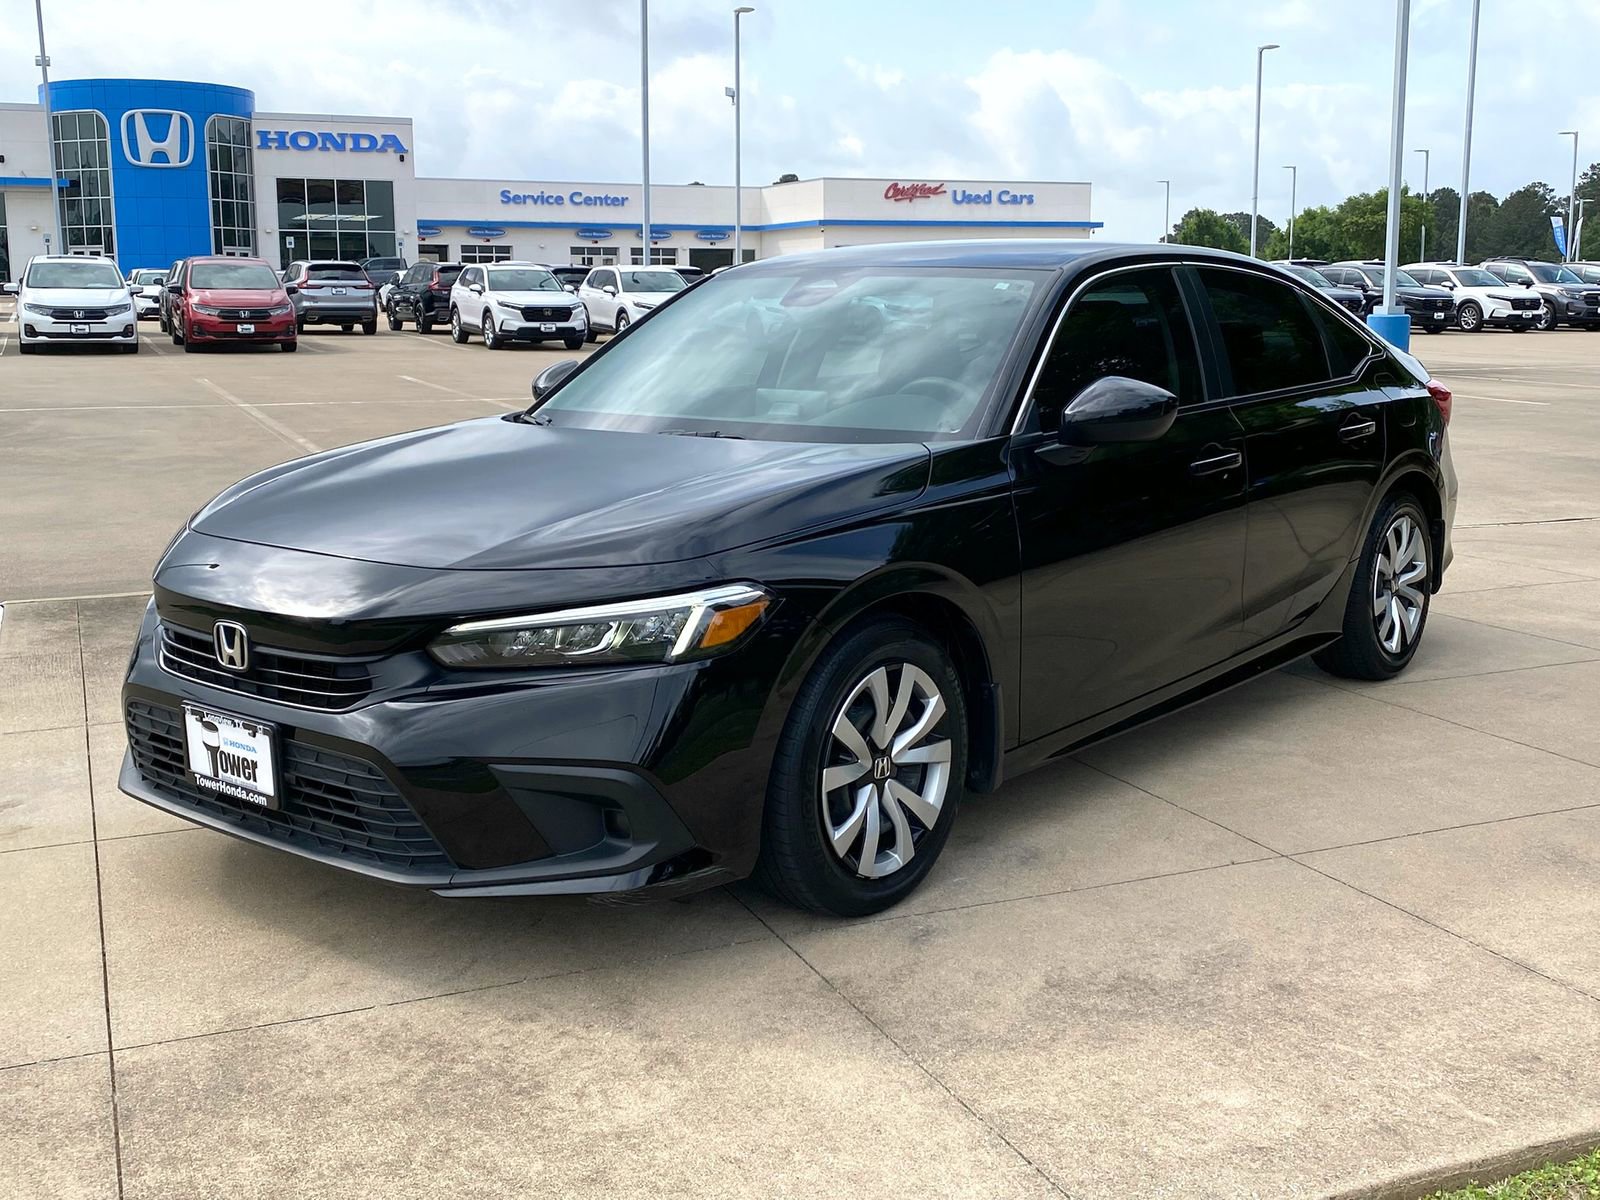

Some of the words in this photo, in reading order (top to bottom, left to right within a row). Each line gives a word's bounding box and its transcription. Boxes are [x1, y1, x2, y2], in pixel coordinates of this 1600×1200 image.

[255, 130, 409, 154] HONDA
[500, 189, 565, 206] Service
[568, 191, 629, 207] Center
[884, 182, 947, 203] Certified
[952, 190, 993, 205] Used
[997, 190, 1035, 205] Cars
[229, 740, 258, 754] HONDA
[195, 774, 268, 806] TowerHonda.com
